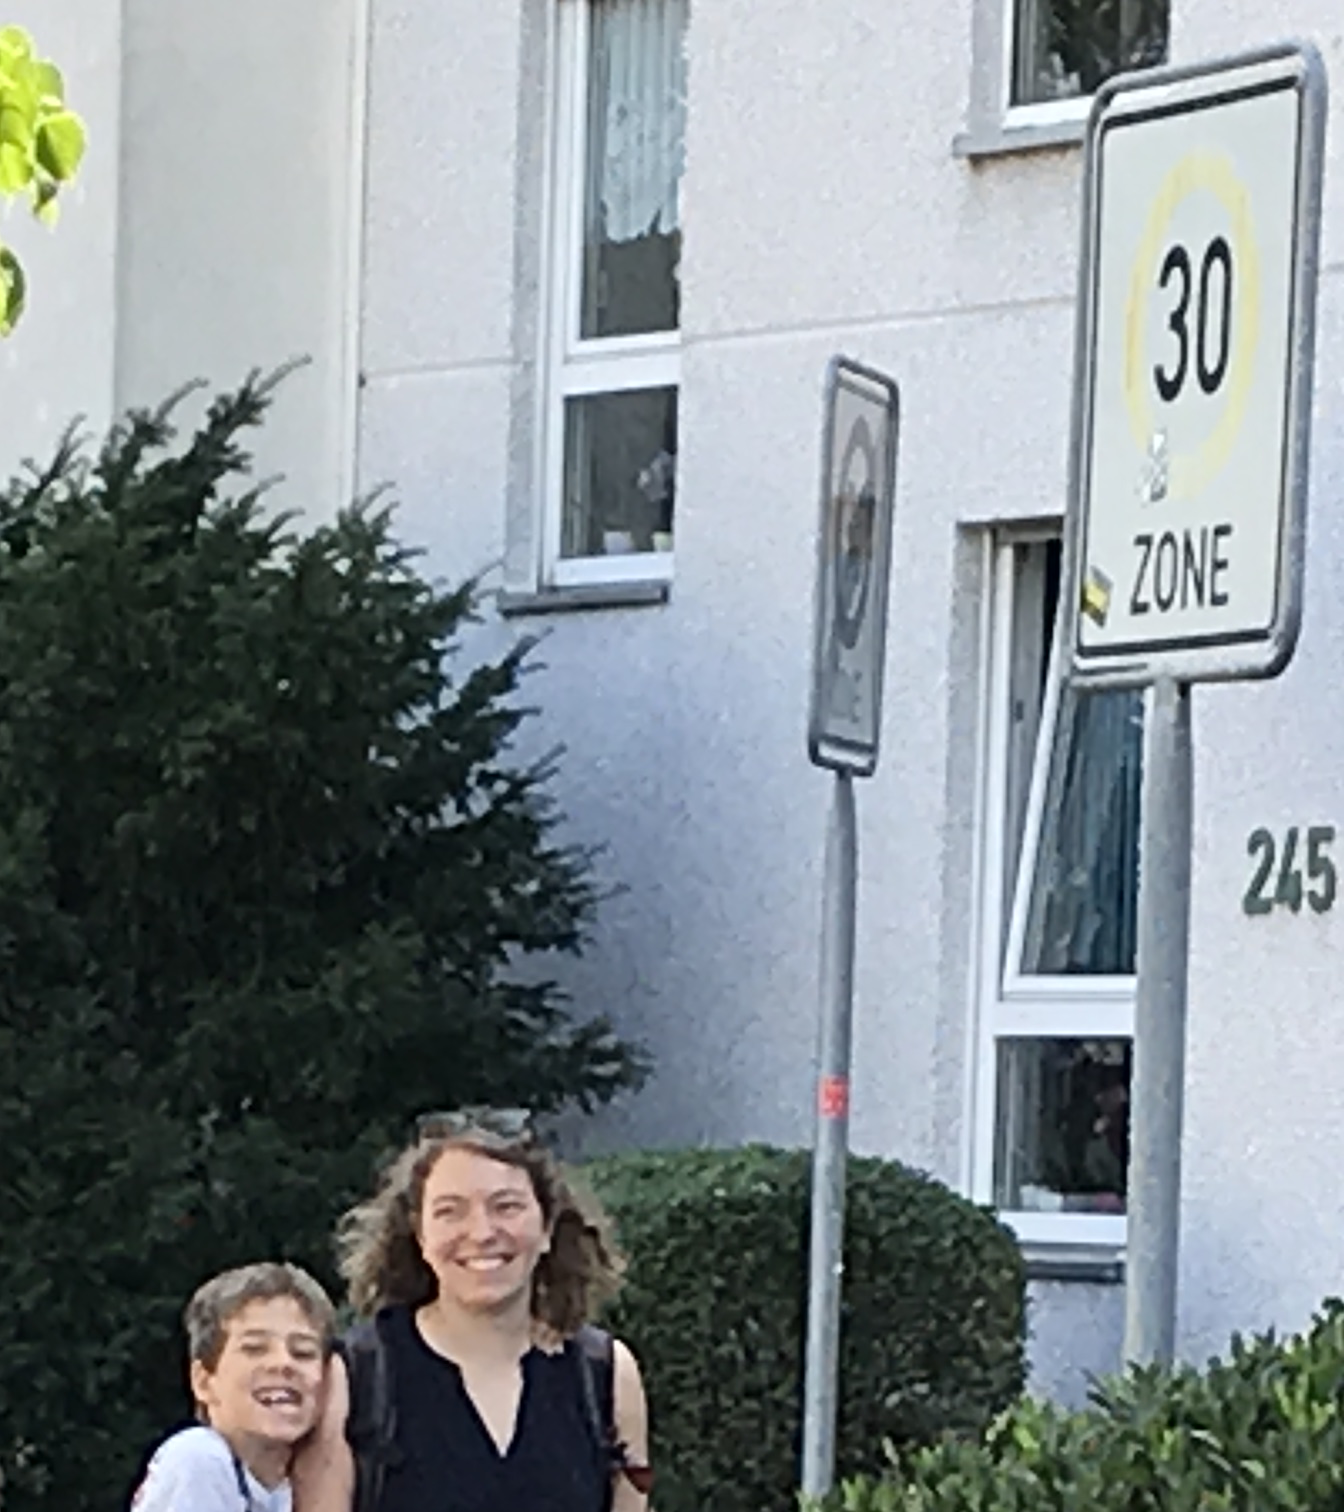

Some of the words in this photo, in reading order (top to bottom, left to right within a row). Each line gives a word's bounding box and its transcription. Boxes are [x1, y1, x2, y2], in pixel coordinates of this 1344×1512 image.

[1154, 236, 1232, 402] 30
[1130, 524, 1233, 615] ZONE
[1243, 826, 1336, 914] 245
